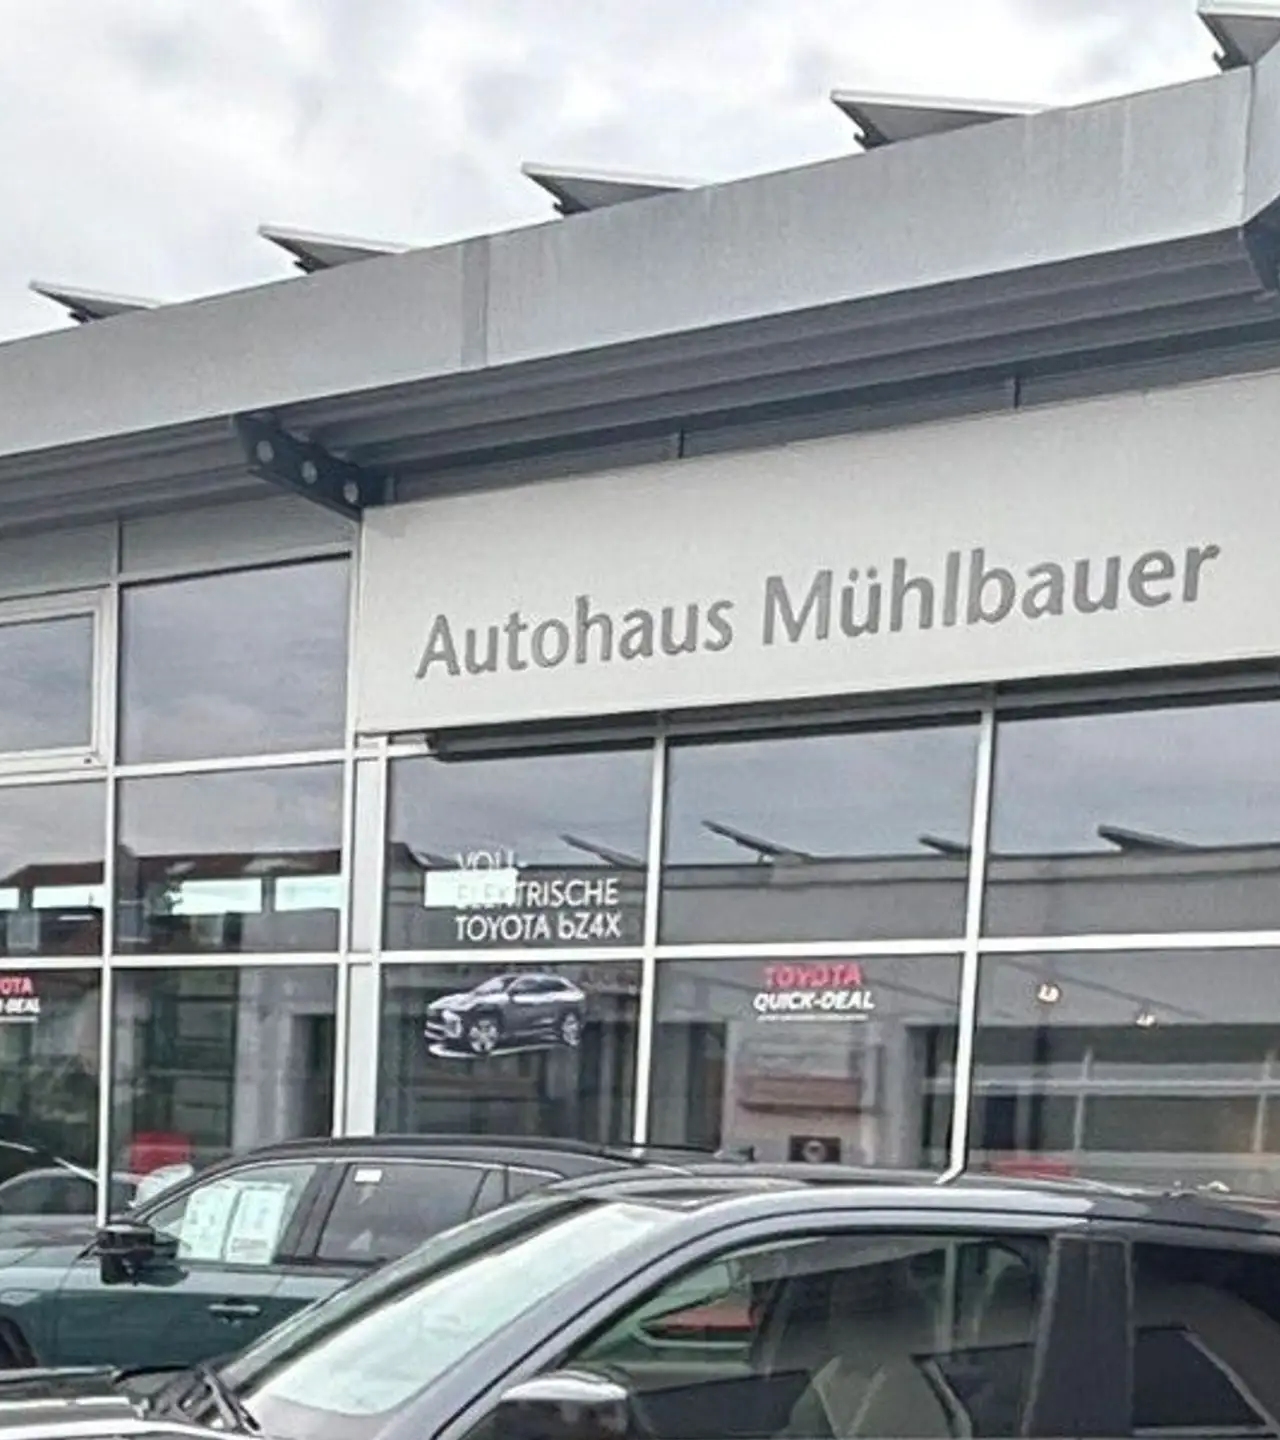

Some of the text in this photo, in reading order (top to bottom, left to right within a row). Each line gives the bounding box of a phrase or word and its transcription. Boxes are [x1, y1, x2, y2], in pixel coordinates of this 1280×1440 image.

[414, 542, 1221, 680] Autohaus Mühlbauer
[455, 910, 622, 941] TOYOTA bZ4X
[764, 963, 863, 989] TOYOTA
[753, 990, 876, 1012] QUICK-DEAL
